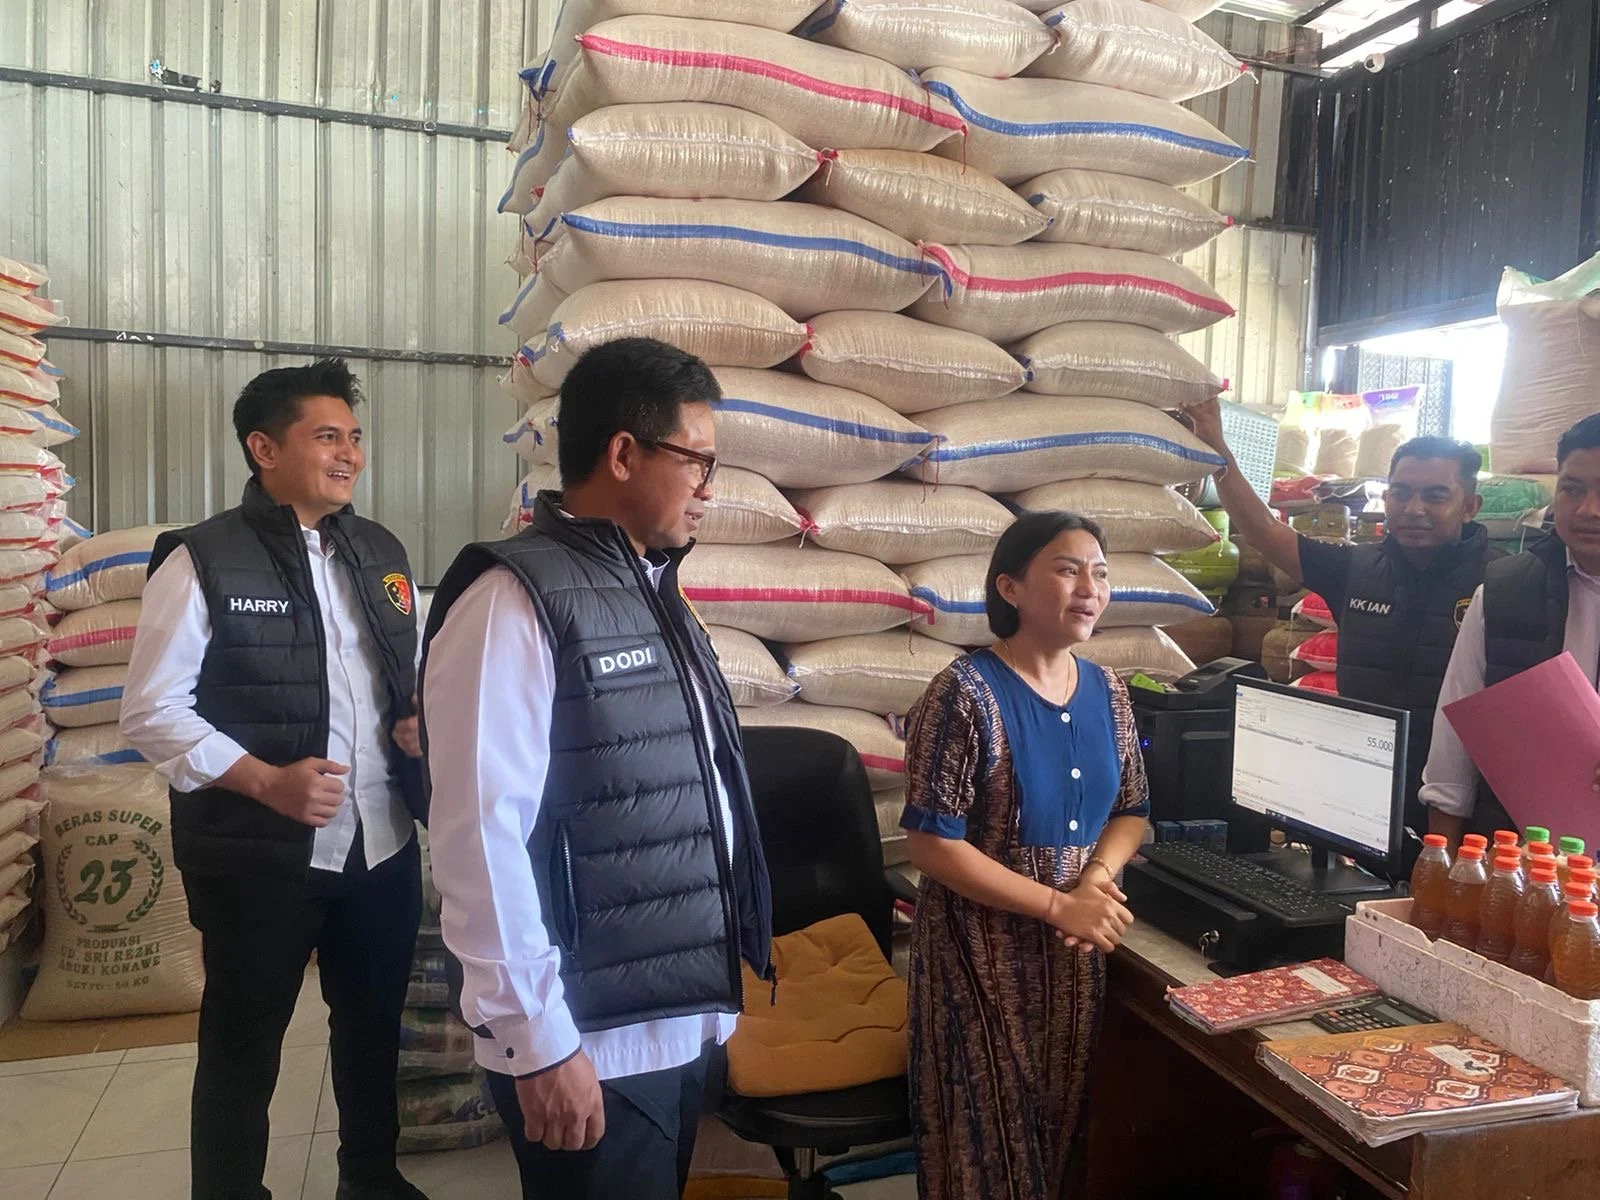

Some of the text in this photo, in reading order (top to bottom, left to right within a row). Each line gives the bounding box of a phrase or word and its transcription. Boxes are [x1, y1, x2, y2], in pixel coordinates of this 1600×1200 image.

[230, 597, 289, 613] HARRY
[599, 647, 652, 674] DODI
[1366, 736, 1394, 753] 55.000
[54, 809, 163, 838] BERAS SUPER
[85, 833, 119, 847] CAP
[73, 857, 138, 905] 23
[77, 934, 141, 950] PRODUKSI
[83, 950, 109, 963] SRI
[113, 941, 160, 962] REZKI
[101, 955, 161, 976] KONAWE
